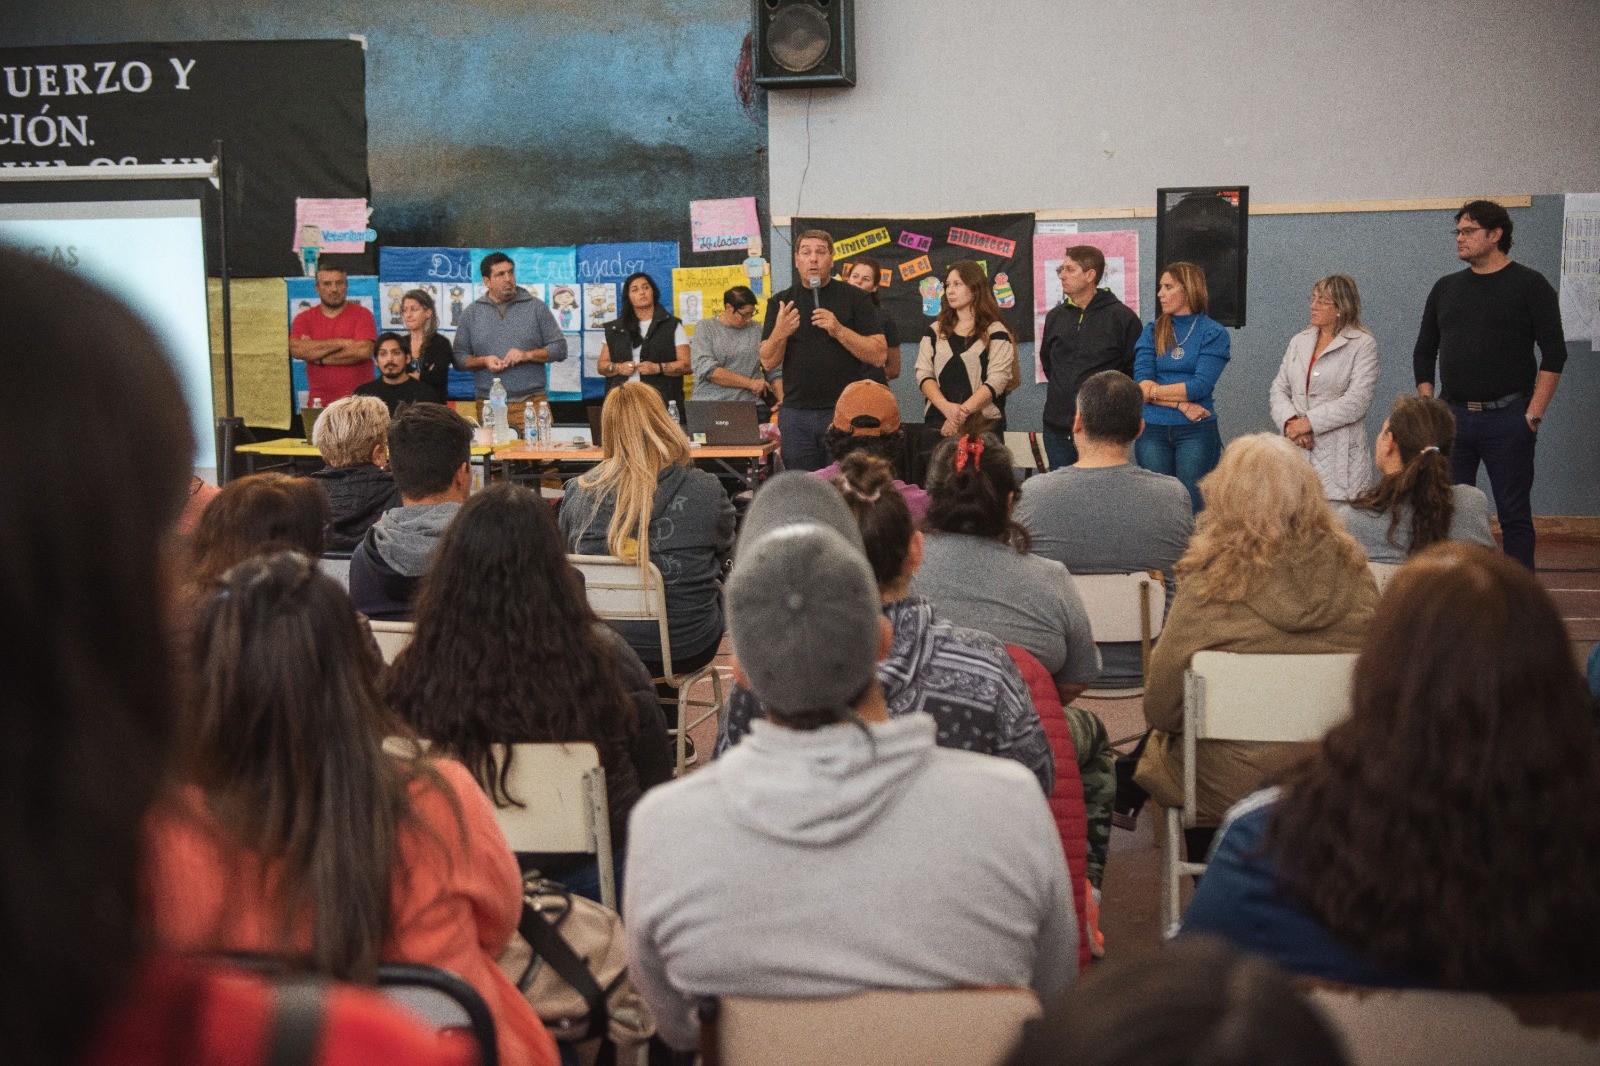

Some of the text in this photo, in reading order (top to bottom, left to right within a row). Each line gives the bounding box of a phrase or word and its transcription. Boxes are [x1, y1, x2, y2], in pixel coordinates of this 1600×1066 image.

[169, 58, 196, 90] Y
[900, 234, 914, 245] de
[917, 237, 929, 249] la
